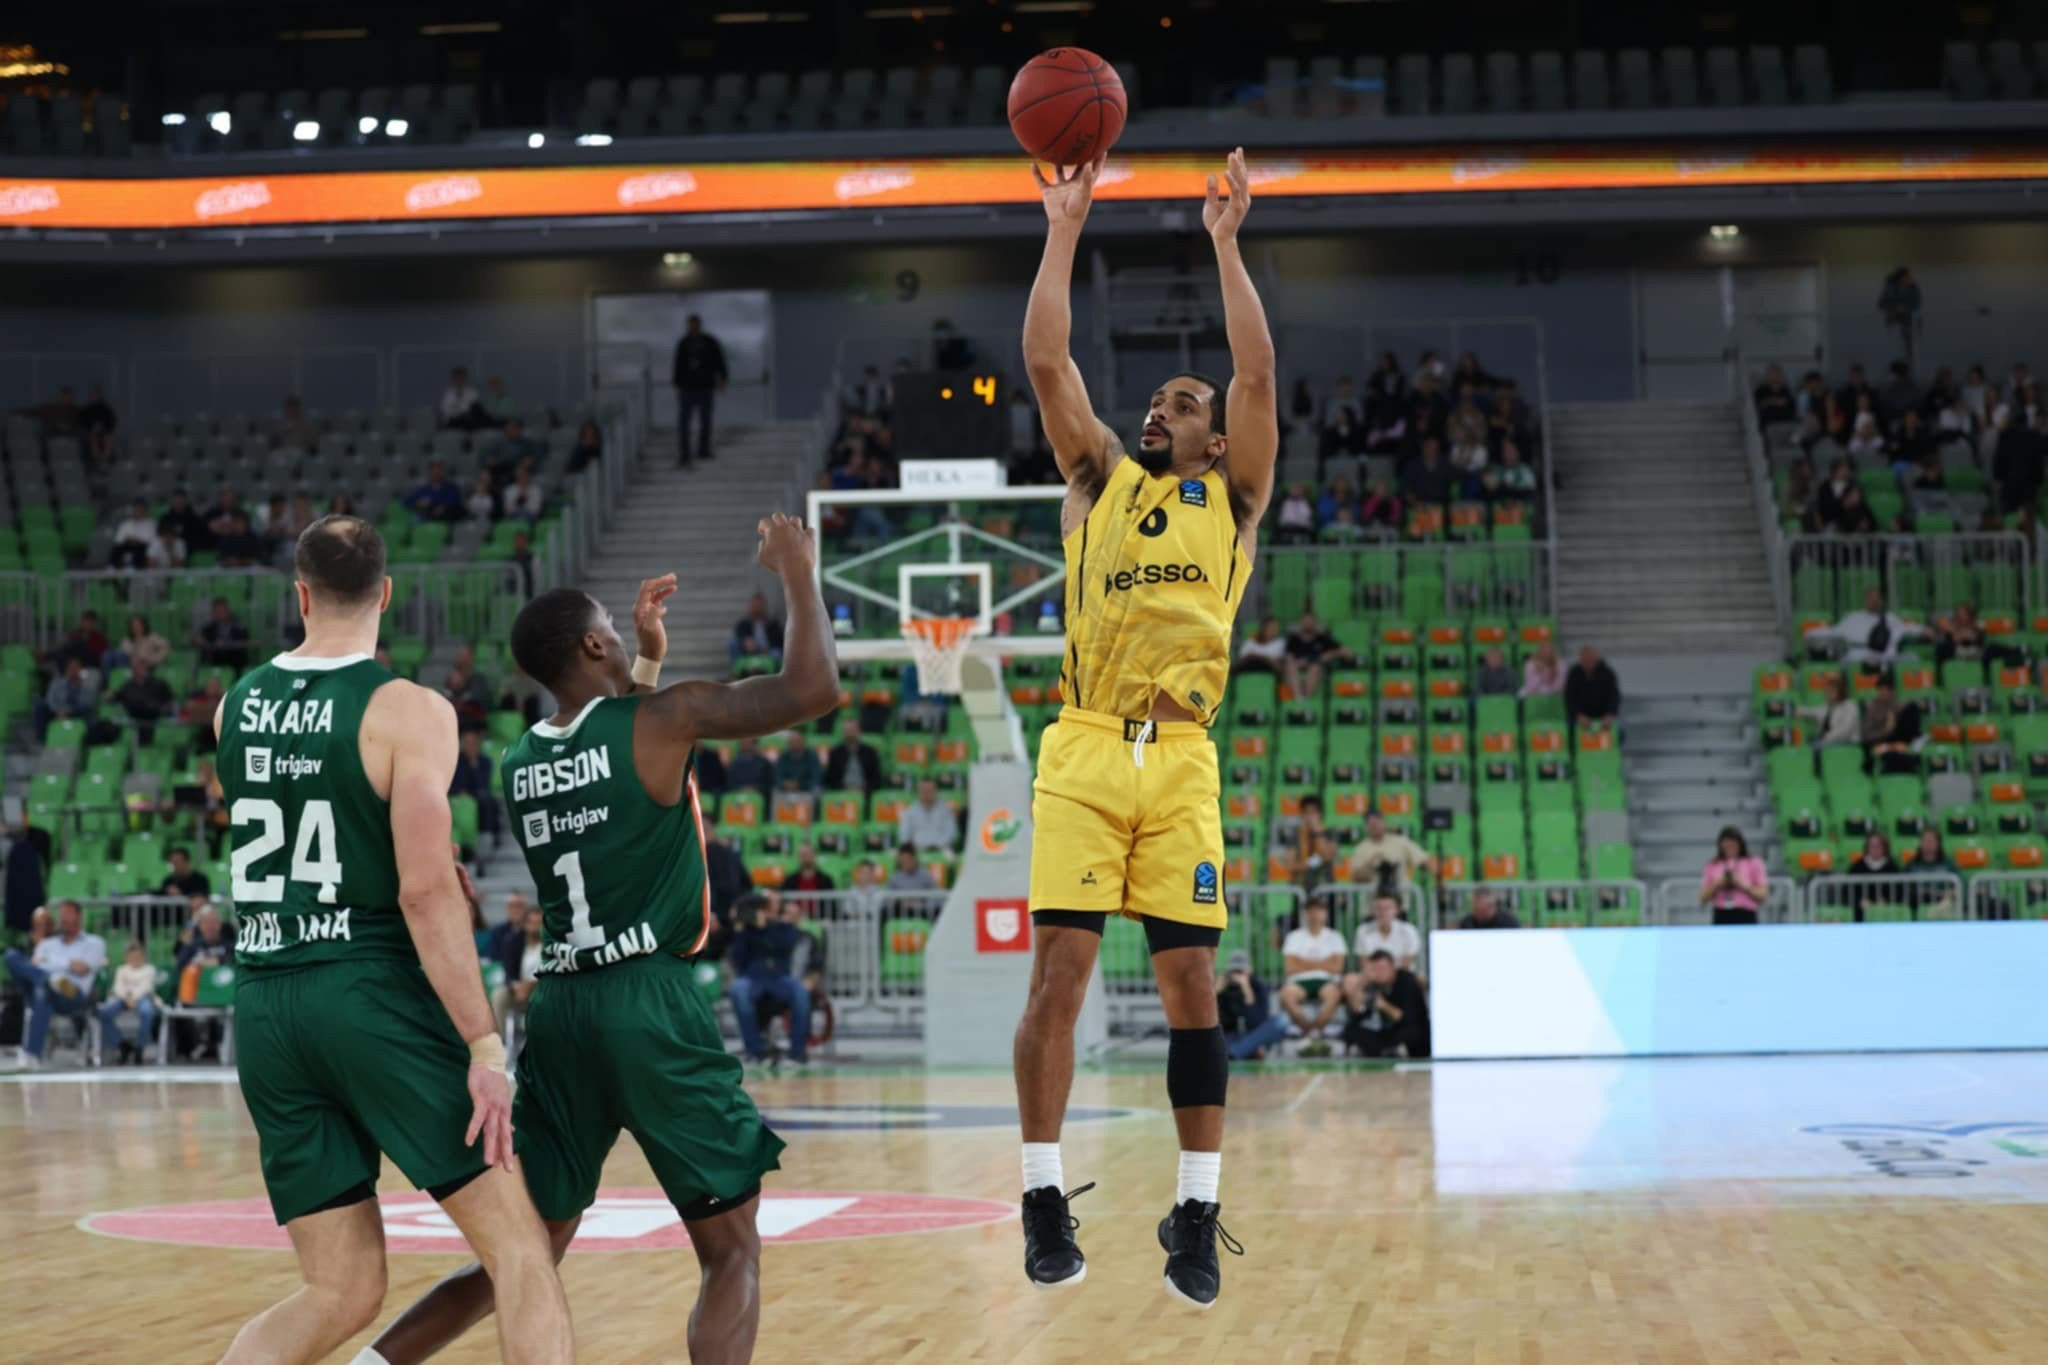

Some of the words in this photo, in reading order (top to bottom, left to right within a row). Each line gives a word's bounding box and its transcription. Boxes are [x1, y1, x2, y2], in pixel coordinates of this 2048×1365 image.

[897, 269, 921, 304] 9
[972, 376, 997, 405] 4
[1105, 562, 1209, 598] etsso
[240, 687, 333, 734] ŠKARA
[274, 753, 323, 780] triglav
[513, 745, 611, 801] GIBSON
[551, 806, 609, 835] triglav
[231, 798, 342, 904] 24
[553, 851, 606, 950] 1
